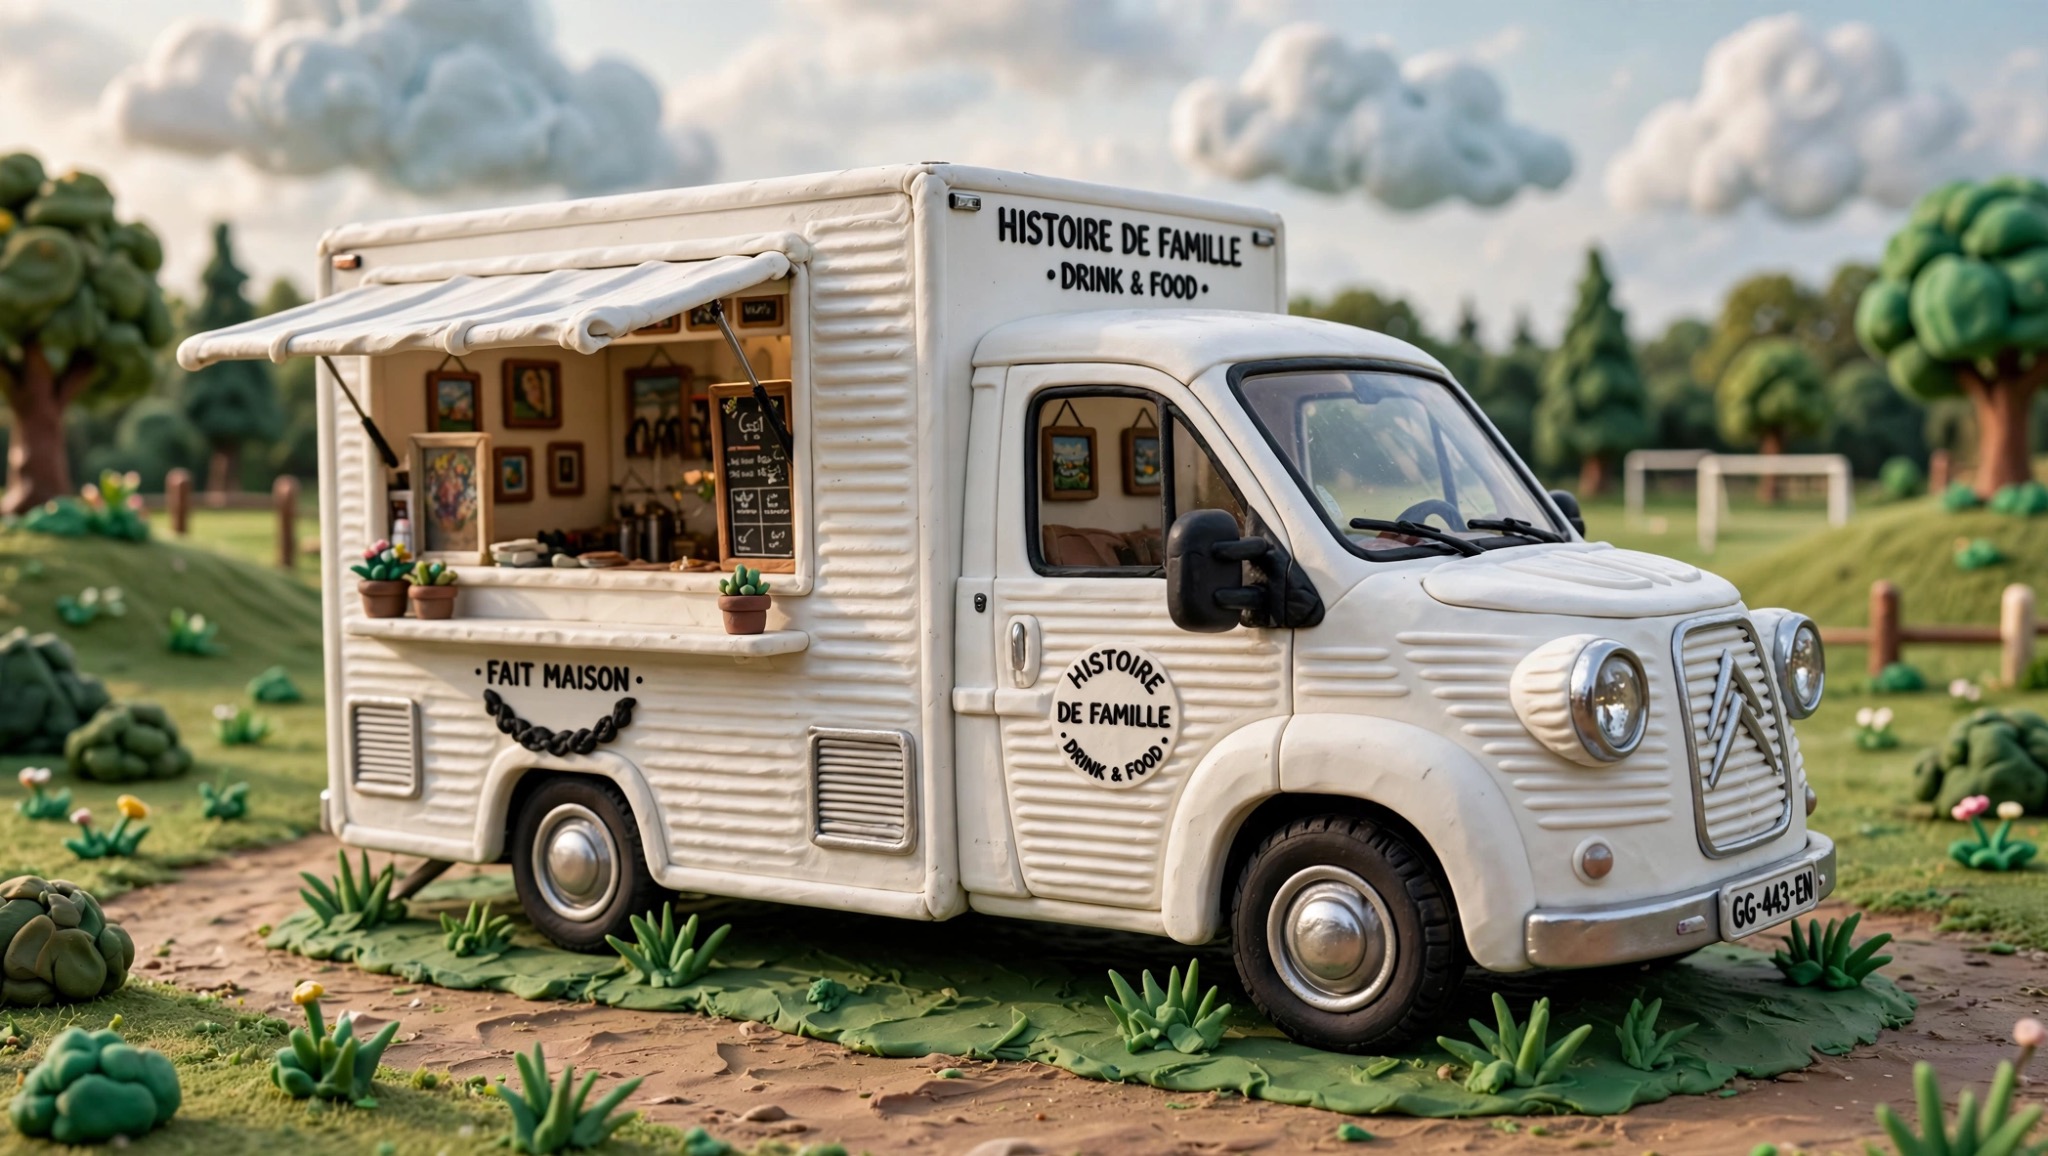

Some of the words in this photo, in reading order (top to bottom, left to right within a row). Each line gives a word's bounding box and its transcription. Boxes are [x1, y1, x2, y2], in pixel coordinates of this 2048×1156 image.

[998, 206, 1114, 253] HISTOIRE
[1121, 222, 1151, 257] DE
[1158, 226, 1243, 268] FAMILLE
[1060, 261, 1125, 295] DRINK
[1130, 270, 1144, 296] &
[1150, 270, 1198, 301] FOOD
[486, 659, 535, 687] FAIT
[543, 662, 630, 693] MAISON
[1066, 648, 1166, 696] HISTOIRE
[1057, 701, 1083, 725] DE
[1089, 702, 1171, 729] FAMILLE
[1062, 738, 1107, 781] DRINK
[1110, 766, 1123, 783] &
[1124, 745, 1163, 781] FOOD
